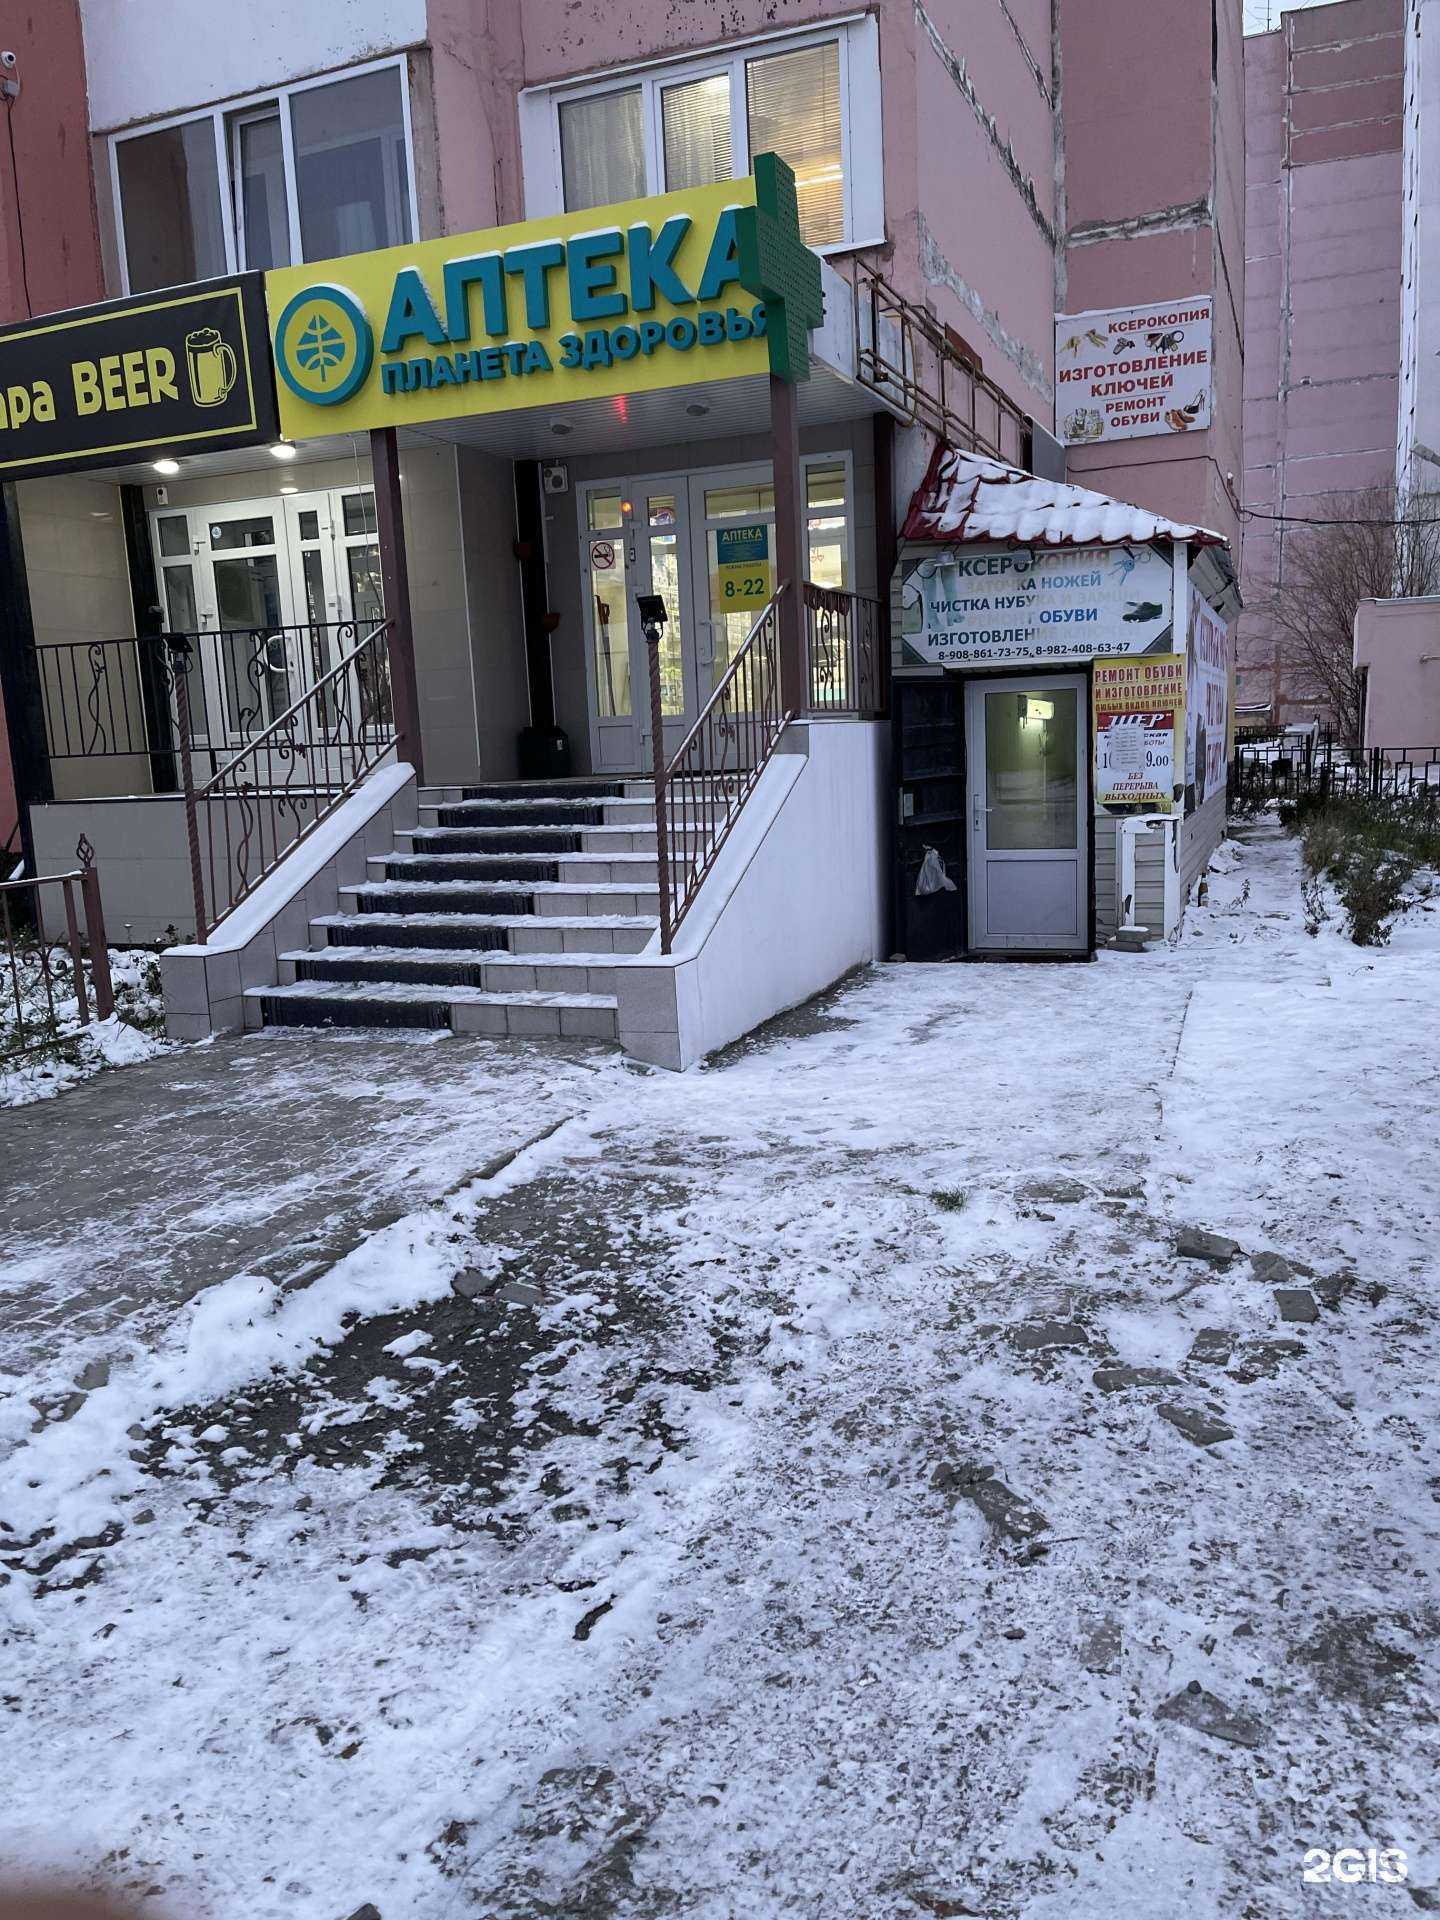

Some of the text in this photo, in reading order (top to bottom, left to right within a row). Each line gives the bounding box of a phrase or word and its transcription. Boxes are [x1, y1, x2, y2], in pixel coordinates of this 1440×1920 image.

[381, 206, 742, 355] АПТЕКА
[1108, 308, 1209, 334] КСЕРОКОПИЯ
[381, 342, 553, 394] ПЛАНЕТА
[1059, 350, 1208, 383] ИЗГОТОВЛЕНИЕ
[71, 347, 179, 416] BEER
[1091, 372, 1174, 397] КЛЮЧЕЙ
[1105, 396, 1167, 413] РЕМОНТ
[1111, 412, 1160, 428] ОБУВИ
[722, 528, 762, 541] АПТЕКА
[725, 578, 765, 598] 8-22
[1041, 570, 1101, 589] НОЖЕЙ
[930, 598, 990, 613] ЧИСТКА
[1039, 608, 1098, 624] ОБУВИ
[1035, 642, 1131, 656] 8-982-408-63-47
[1095, 663, 1182, 683] РЕМОНТ ОБУВИ
[1095, 682, 1182, 699] И ИЗГОТОВЛЕНИЕ
[1128, 772, 1143, 780] БЕЗ
[1112, 782, 1159, 791] ПЕРЕРЫВА
[1105, 791, 1166, 801] ВЫХОДНЫХ
